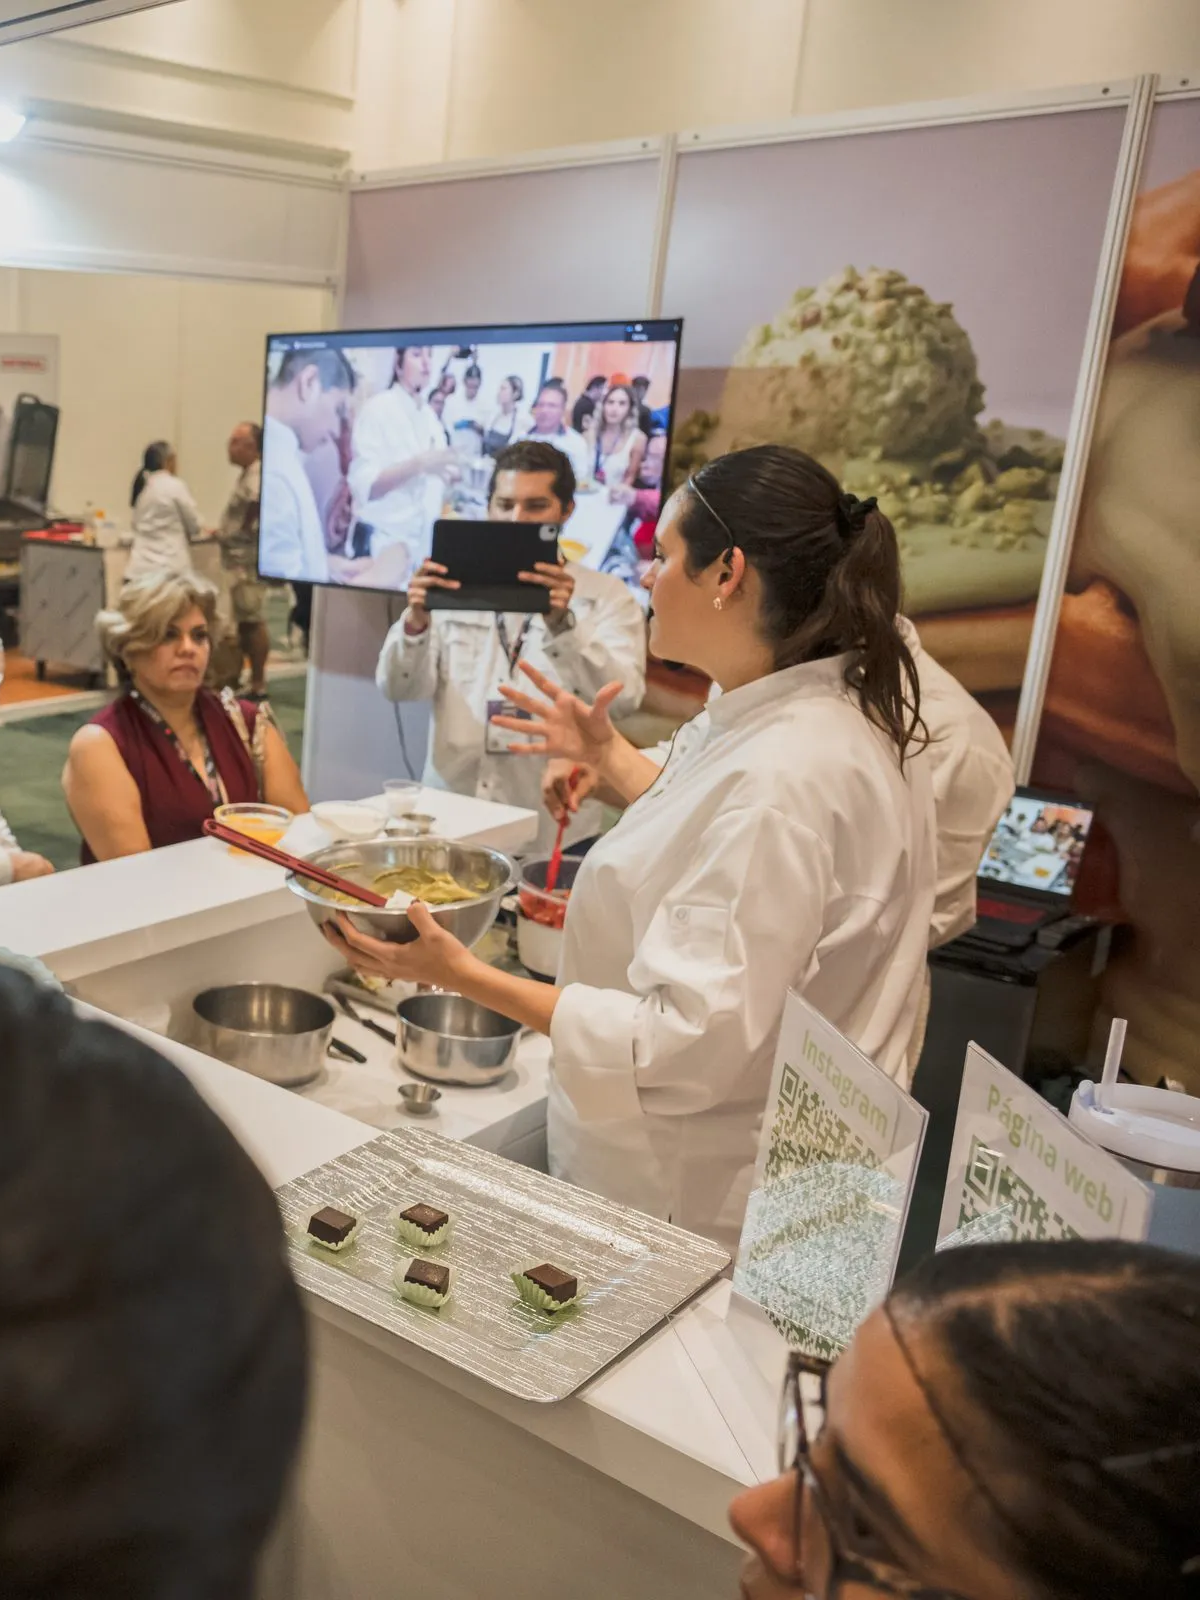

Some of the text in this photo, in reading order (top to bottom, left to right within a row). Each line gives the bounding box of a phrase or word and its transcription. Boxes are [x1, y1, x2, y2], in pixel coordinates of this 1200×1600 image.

[802, 1029, 888, 1139] Instagram
[987, 1083, 1114, 1223] Página web
